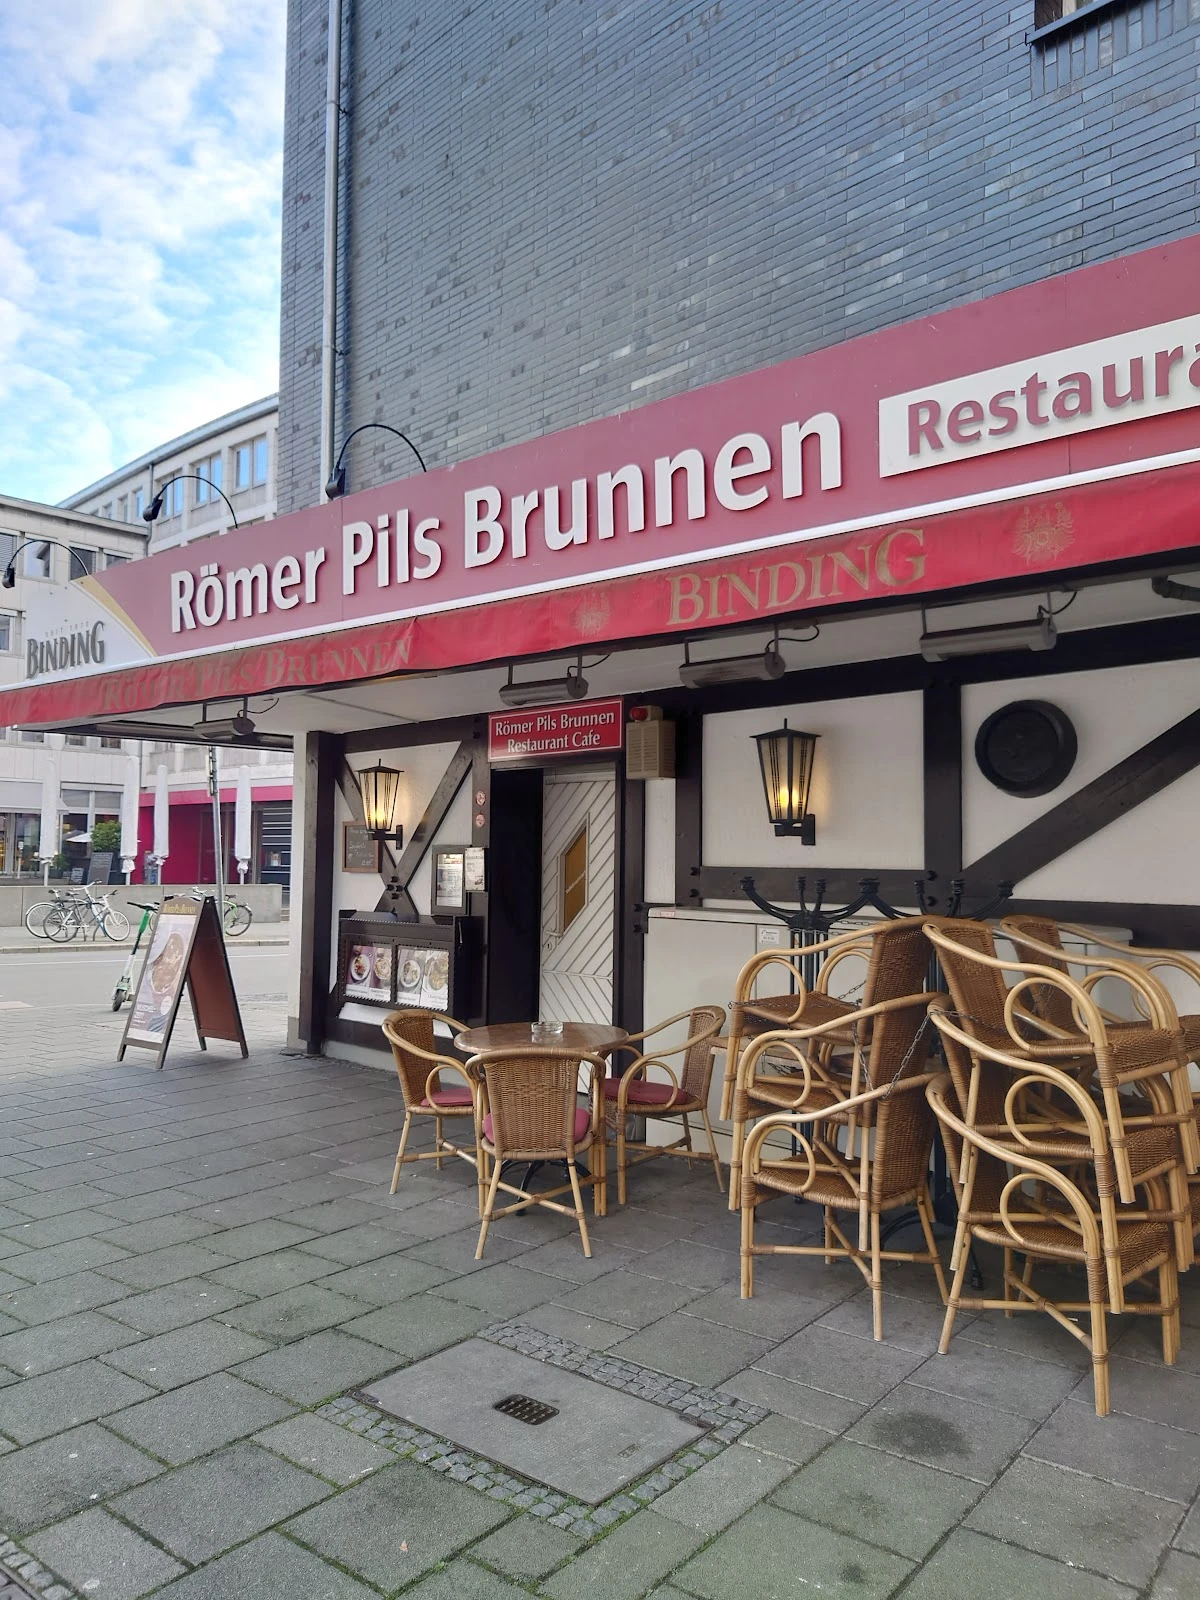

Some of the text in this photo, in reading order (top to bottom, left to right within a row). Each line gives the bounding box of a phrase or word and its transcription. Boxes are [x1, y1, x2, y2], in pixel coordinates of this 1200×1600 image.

[907, 343, 1200, 457] Restaur
[170, 411, 842, 634] Römer Pils Brunnen
[665, 528, 928, 627] BINDING
[26, 620, 105, 680] BINDING
[264, 637, 412, 687] BRUNNEN
[495, 711, 615, 736] Römer Pils Brunnen
[507, 730, 601, 753] Restaurant Cafe
